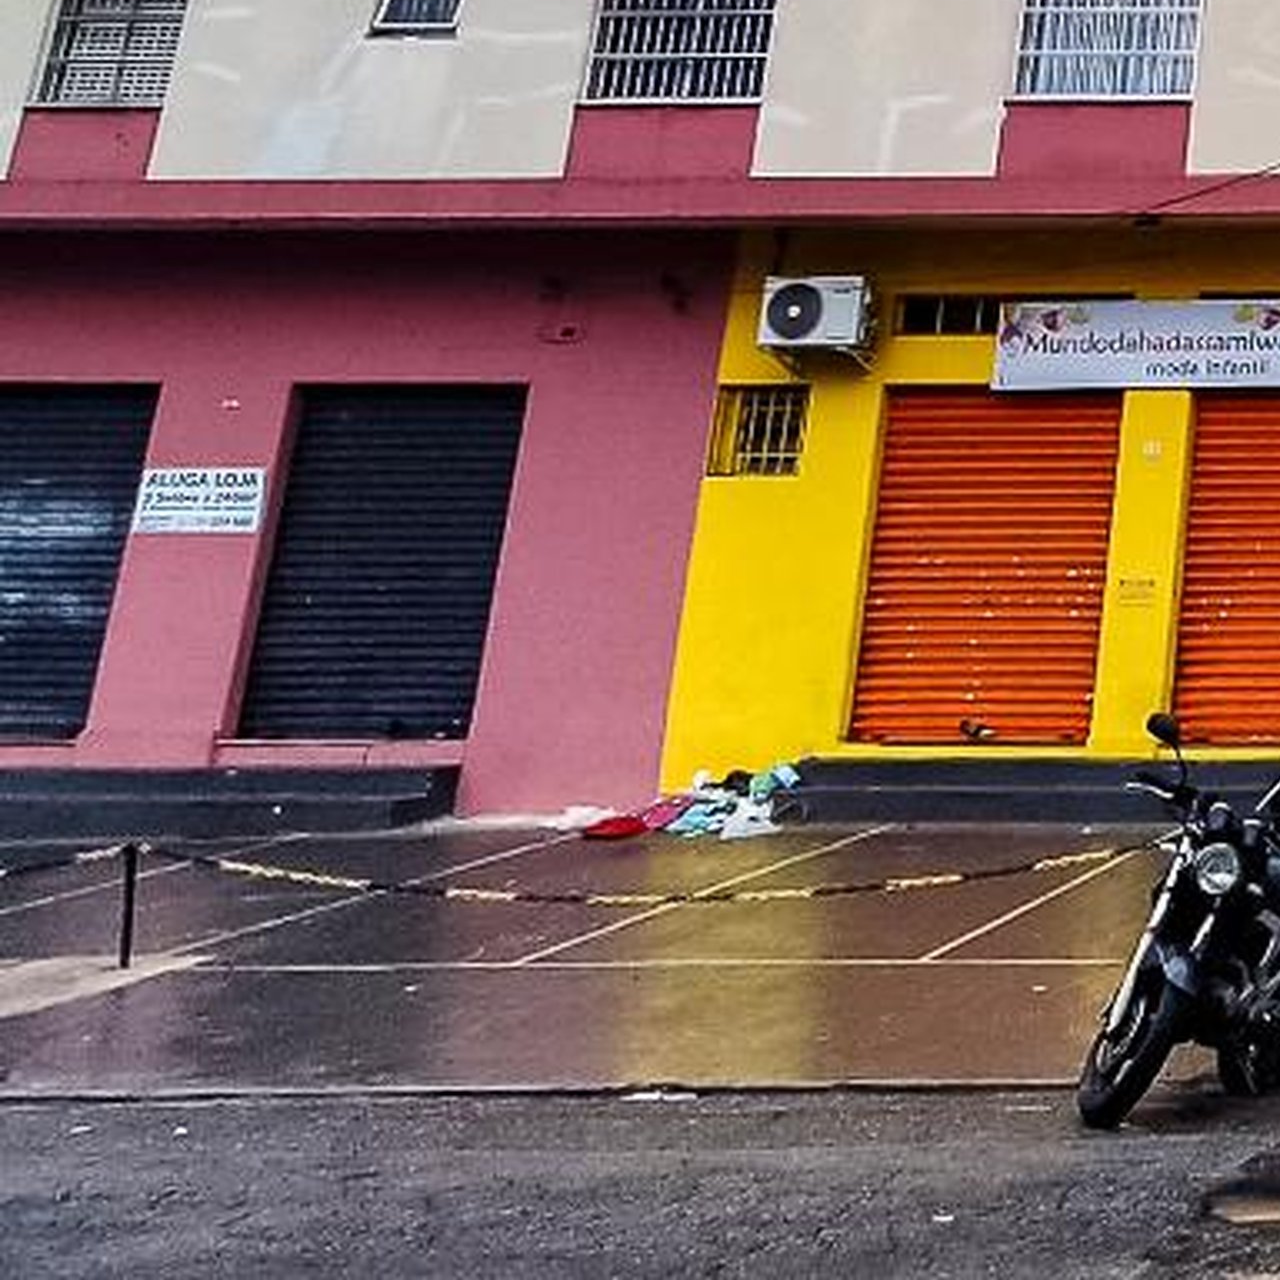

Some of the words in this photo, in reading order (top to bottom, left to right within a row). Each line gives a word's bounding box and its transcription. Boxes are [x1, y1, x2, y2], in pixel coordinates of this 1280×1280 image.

[1145, 358, 1198, 376] moda
[1205, 357, 1268, 375] infantil
[145, 472, 211, 488] ALUGA
[215, 472, 258, 488] LOJA
